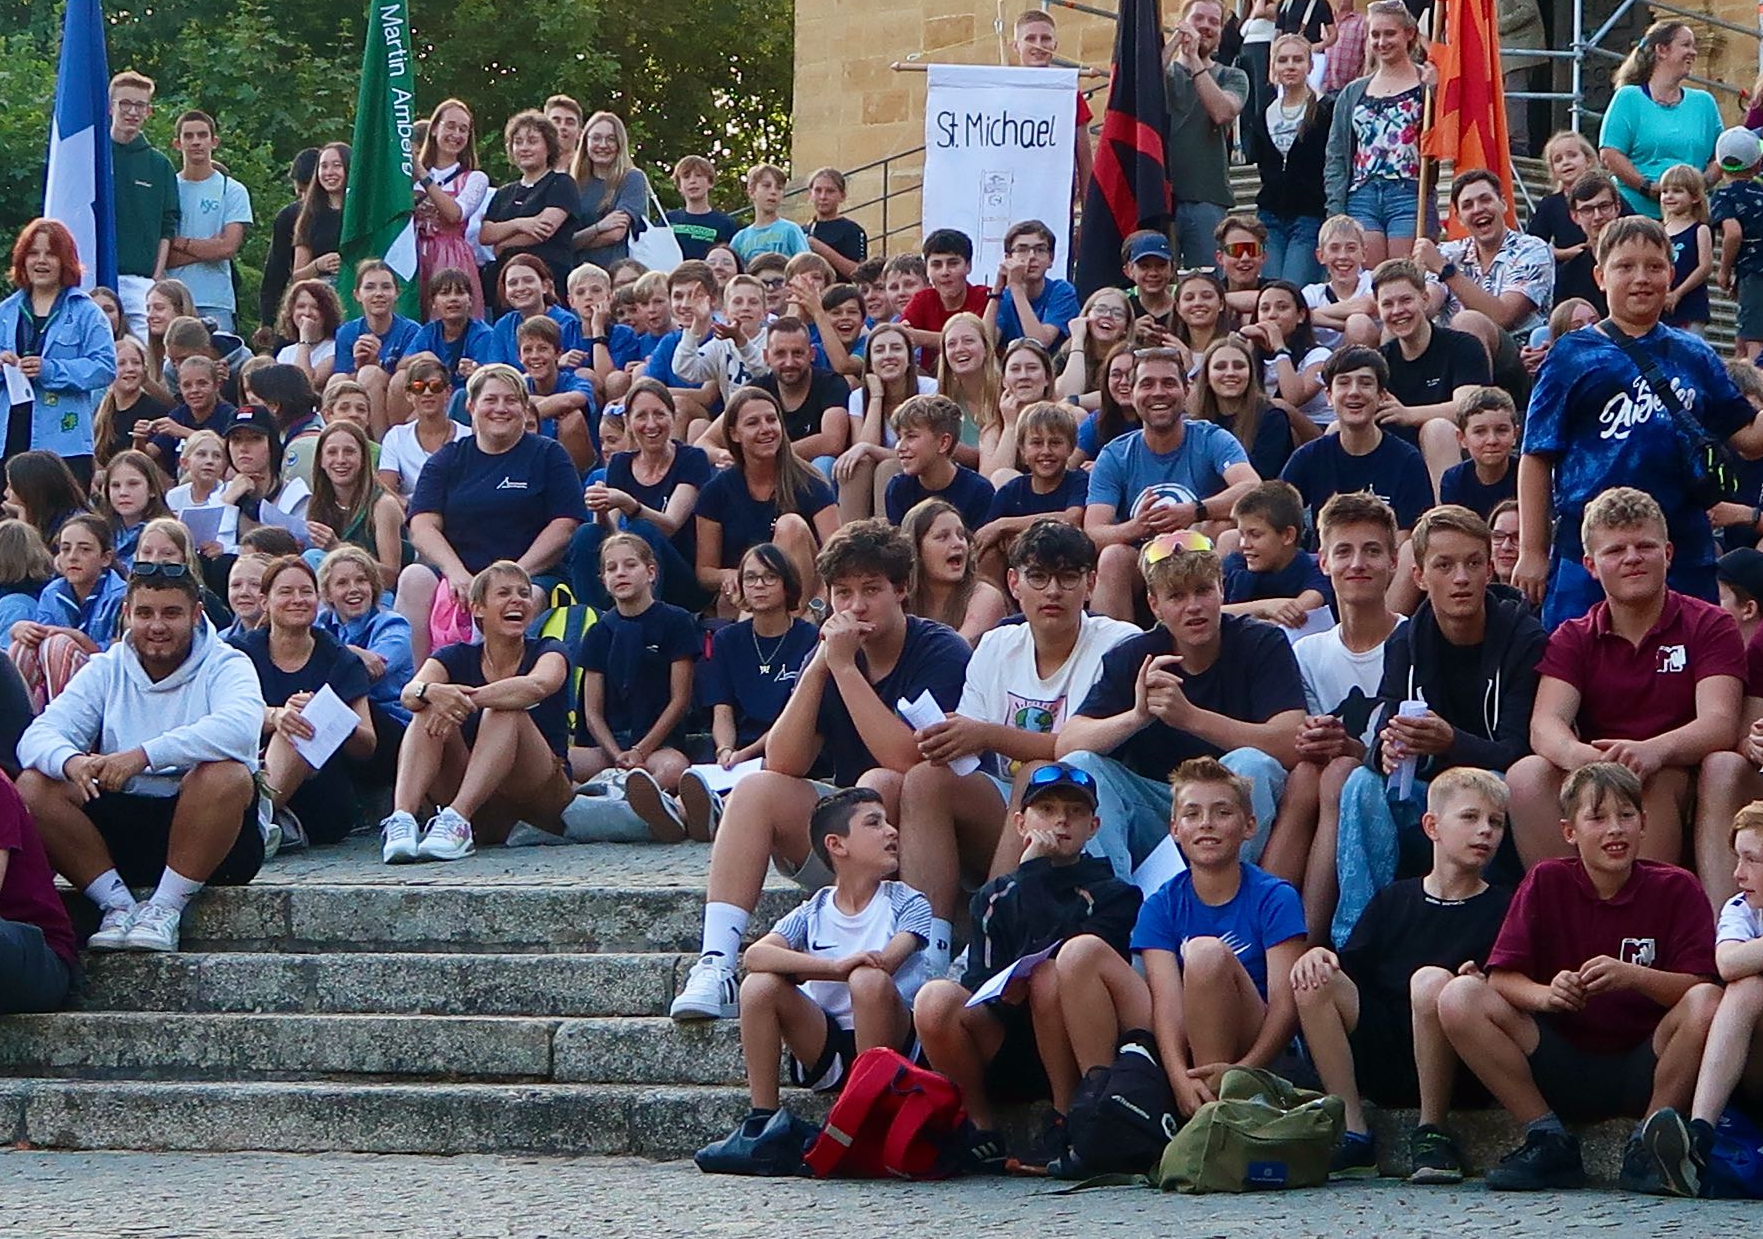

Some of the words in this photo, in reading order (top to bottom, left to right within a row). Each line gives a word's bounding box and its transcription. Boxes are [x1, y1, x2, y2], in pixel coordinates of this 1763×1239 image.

[380, 4, 407, 77] Martin
[936, 110, 959, 148] St.
[965, 110, 1056, 149] Michael
